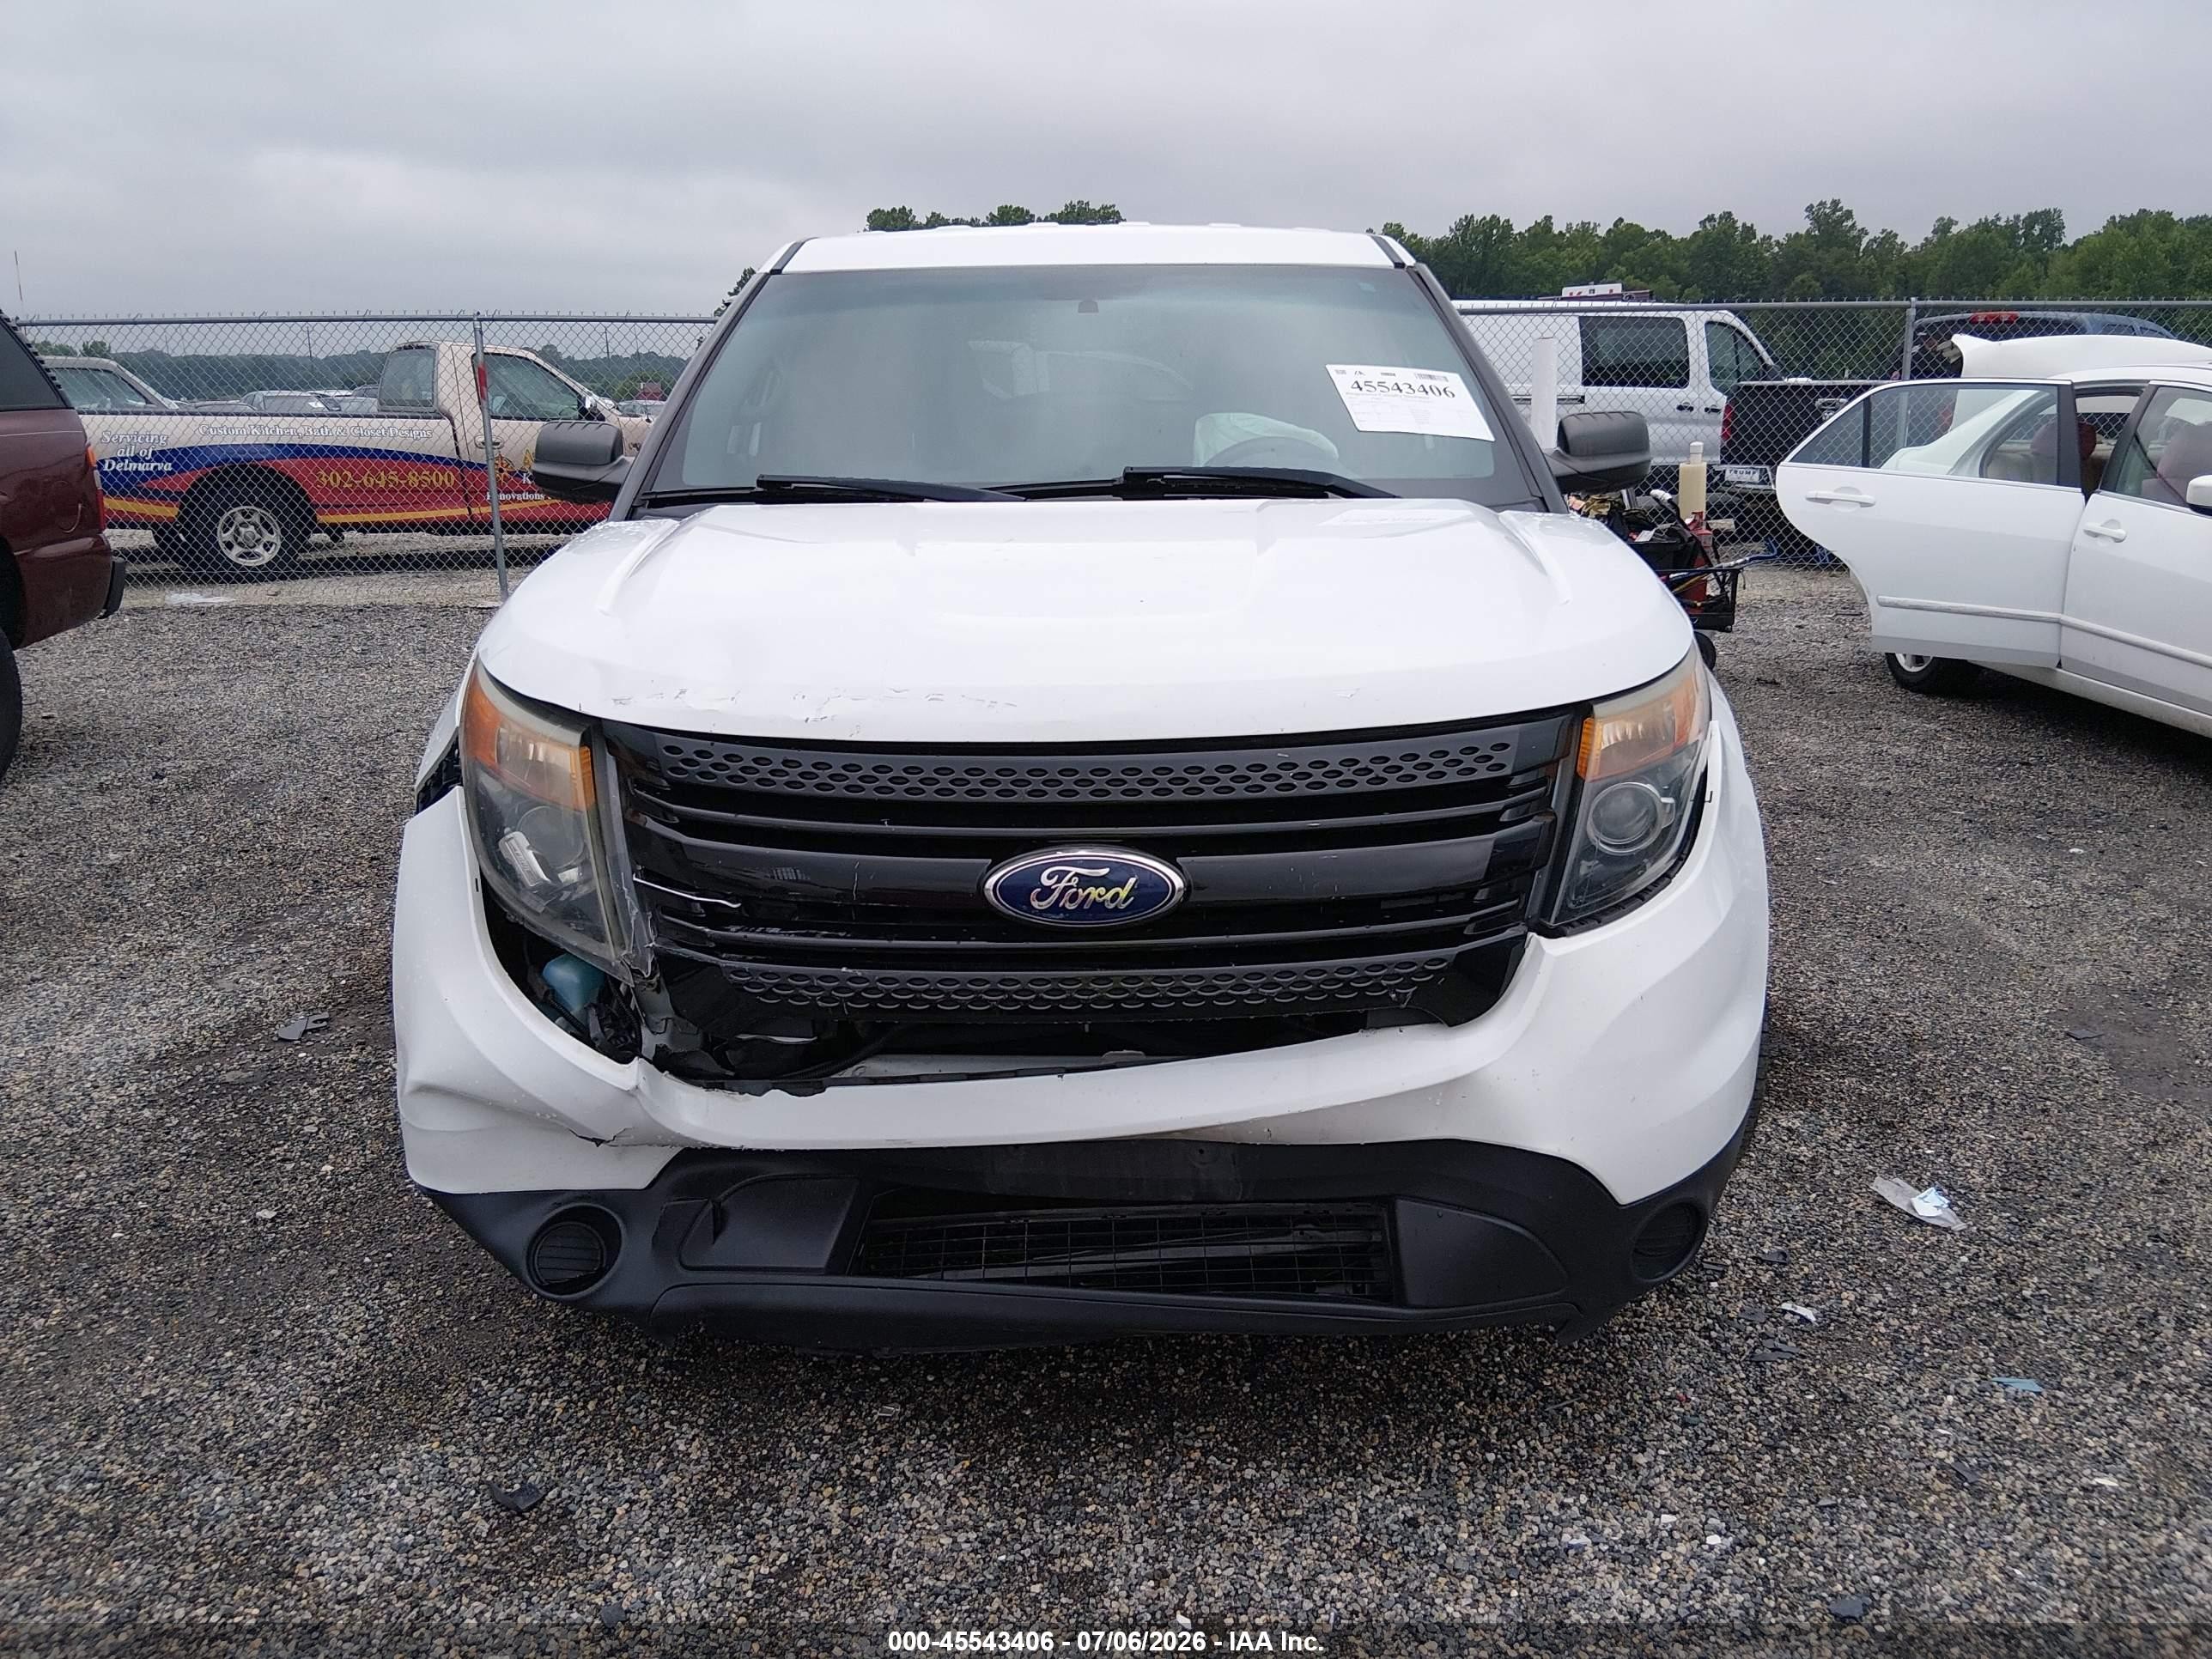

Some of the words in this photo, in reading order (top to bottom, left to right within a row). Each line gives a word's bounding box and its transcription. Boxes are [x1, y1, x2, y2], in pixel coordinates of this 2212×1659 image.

[1350, 380, 1455, 399] 45543406
[101, 431, 168, 447] Servicing
[198, 424, 246, 436] Custom
[304, 426, 332, 437] Bath
[335, 426, 346, 438] &
[350, 427, 387, 438] Closet
[390, 427, 433, 440] Designs
[117, 447, 135, 458] all
[139, 445, 155, 460] of
[102, 459, 173, 472] Delmarva
[316, 470, 455, 489] 302-645-8500
[1030, 865, 1139, 910] Ford
